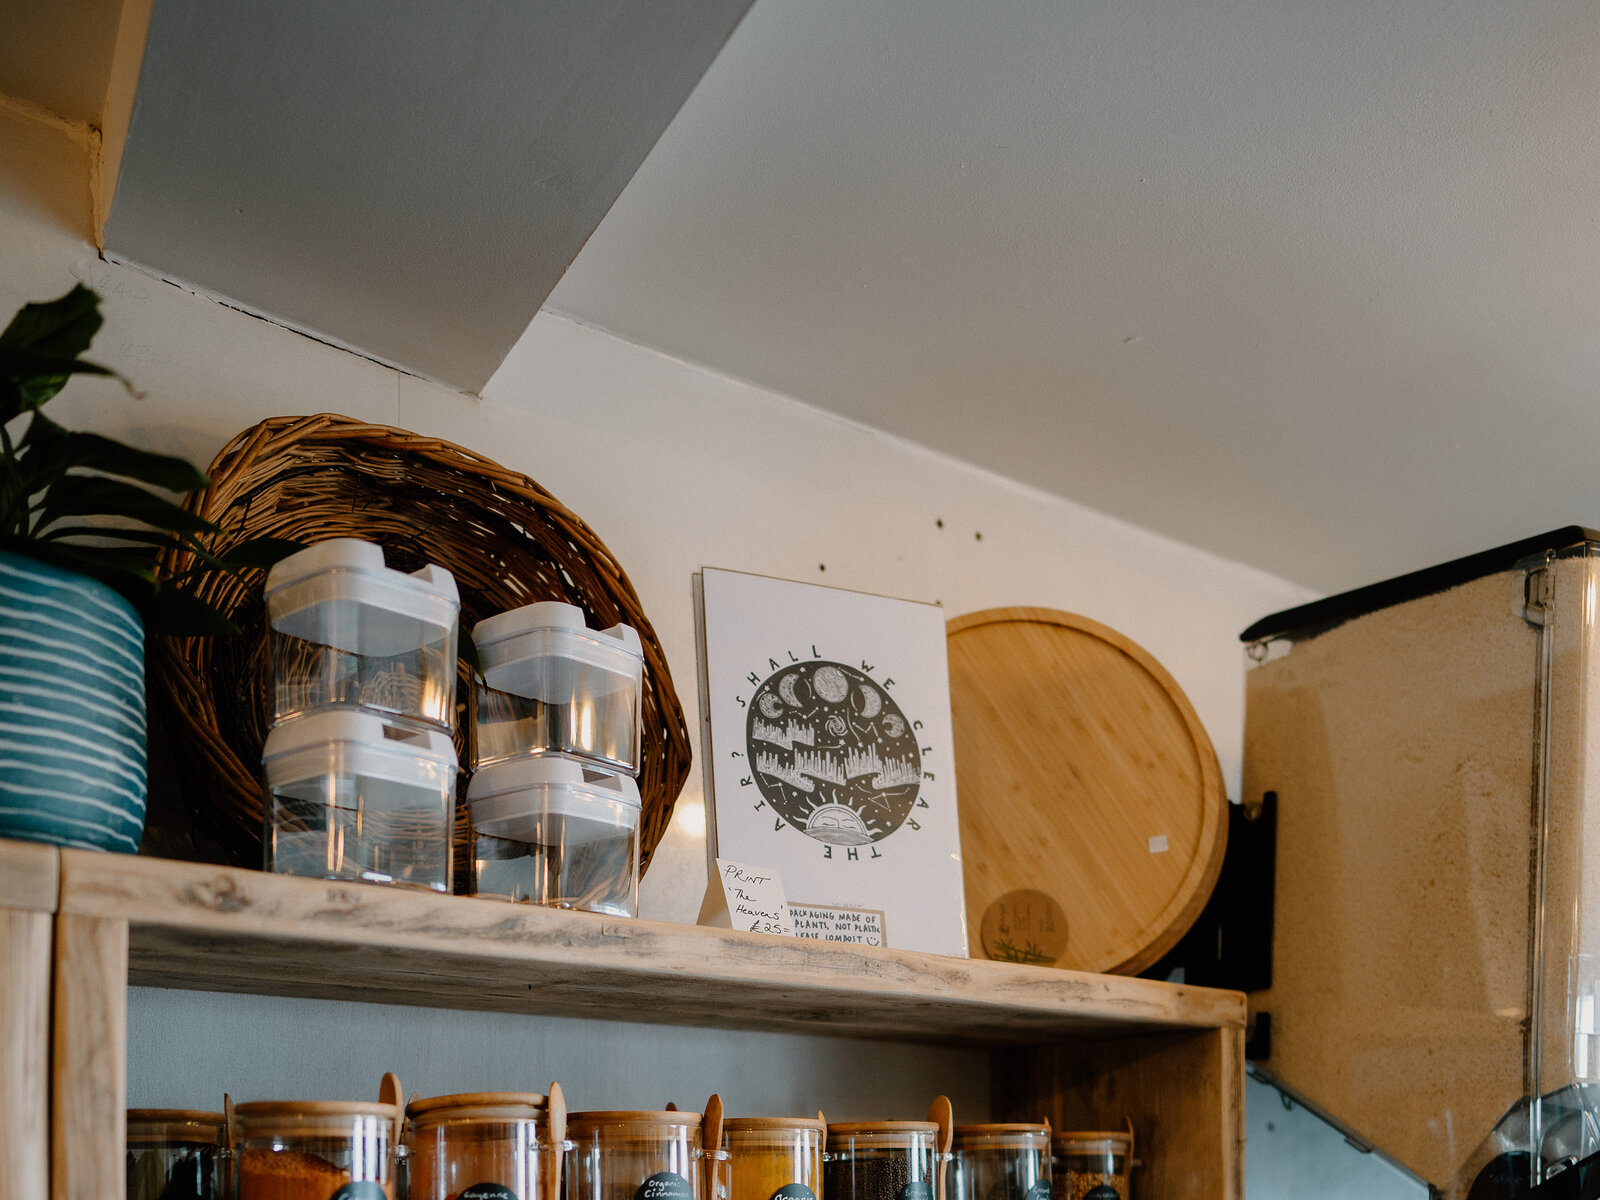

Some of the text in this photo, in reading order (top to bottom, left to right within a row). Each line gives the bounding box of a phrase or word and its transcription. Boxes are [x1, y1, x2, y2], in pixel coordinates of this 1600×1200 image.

[736, 645, 822, 708] SHALL
[861, 659, 896, 691] WE
[905, 720, 935, 831] CLEAR
[731, 751, 786, 832] AIR?
[823, 844, 882, 861] THE
[724, 864, 772, 885] PRINT
[789, 909, 876, 924] PACKAGING MADE OF
[835, 922, 852, 931] NOT
[854, 923, 881, 934] PLASTIC
